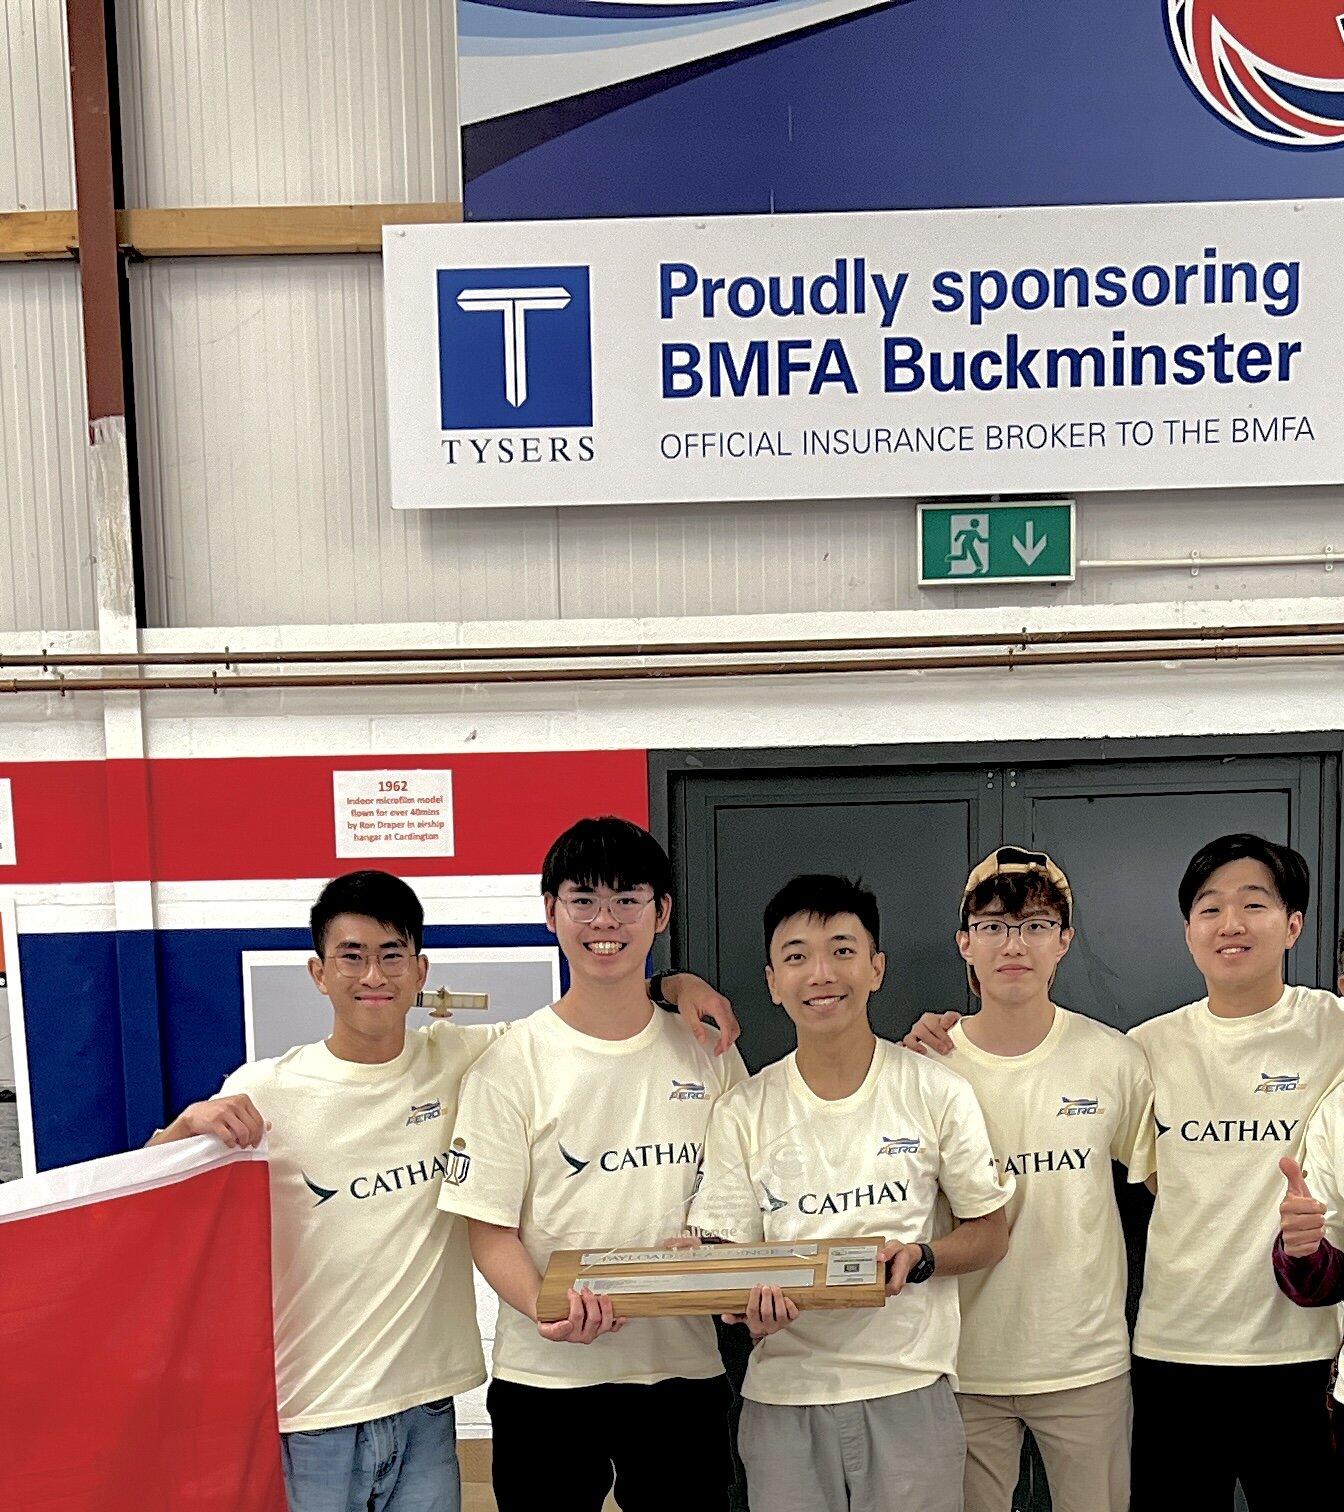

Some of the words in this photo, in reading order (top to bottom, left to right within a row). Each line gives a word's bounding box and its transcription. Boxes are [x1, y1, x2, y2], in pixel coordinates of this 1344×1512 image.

[660, 257, 909, 328] Proudly
[931, 247, 1302, 325] sponsoring
[661, 337, 859, 400] BMFA
[883, 331, 1302, 393] Buckminster
[441, 436, 596, 465] TYSERS
[660, 430, 794, 460] OFFICIAL
[802, 425, 974, 456] INSURANCE
[986, 422, 1106, 451] BROKER
[1116, 420, 1154, 446] TO
[1163, 418, 1220, 445] THE
[1231, 415, 1315, 443] BMFA
[378, 781, 408, 792] 1962
[1180, 1119, 1299, 1143] CATHAY
[599, 1143, 702, 1172] CATHAY
[995, 1147, 1092, 1176] ATHAY
[798, 1179, 911, 1215] CATHAY
